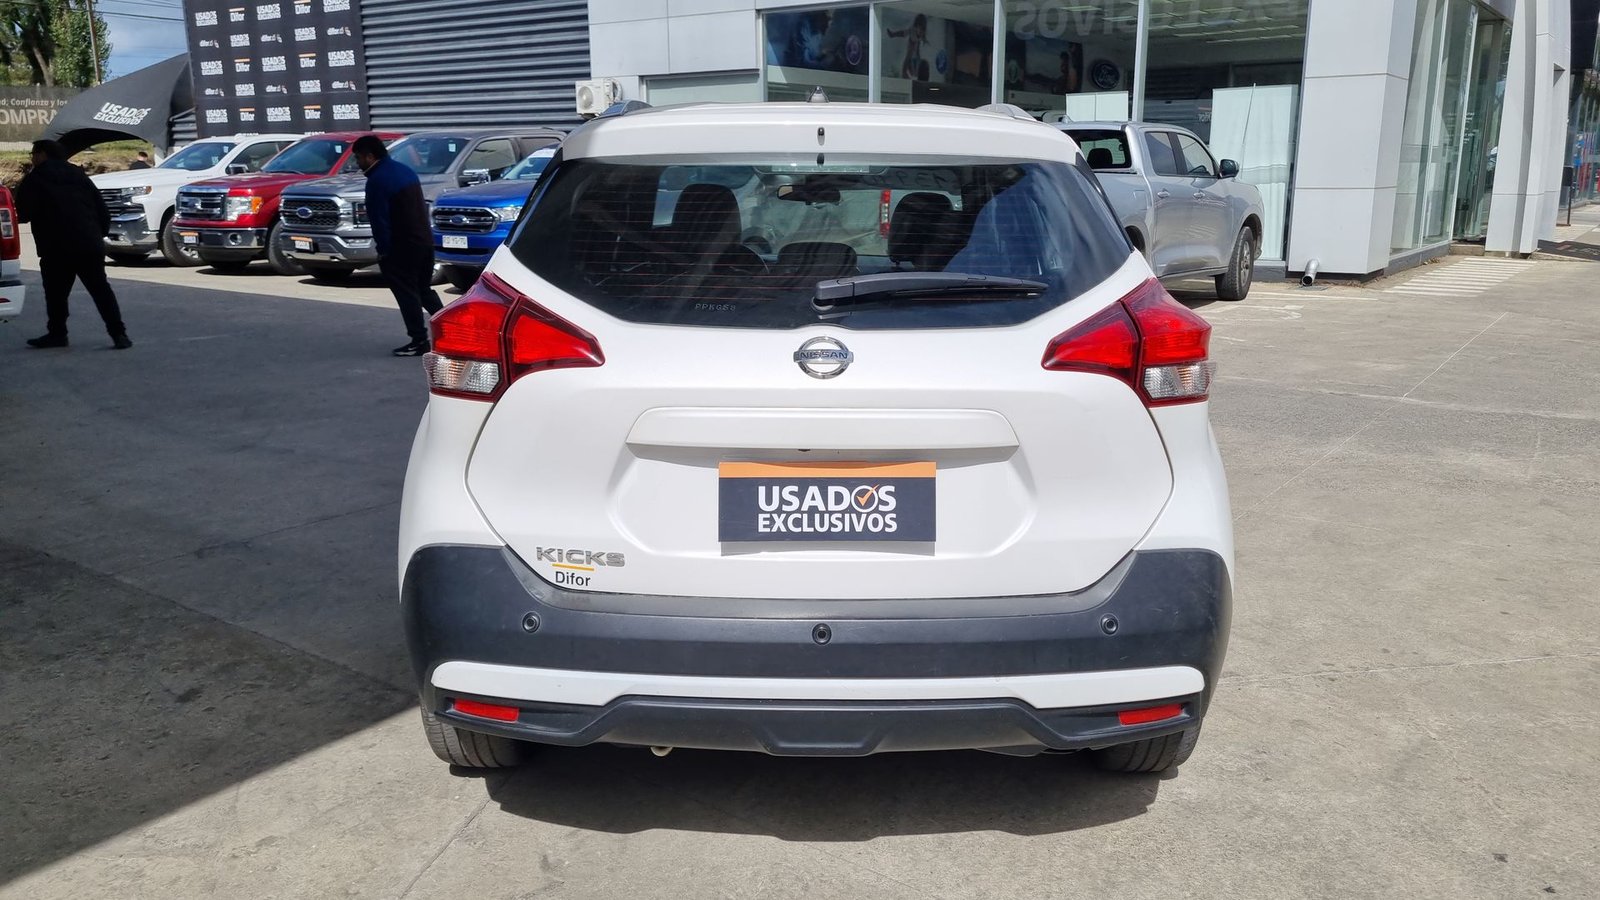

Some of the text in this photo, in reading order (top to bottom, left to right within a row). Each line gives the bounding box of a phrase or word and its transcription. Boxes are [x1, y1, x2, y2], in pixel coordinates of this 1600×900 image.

[101, 102, 151, 118] USADOS
[93, 112, 143, 125] EXCLUSIVOS
[800, 351, 848, 359] NISSAN
[758, 485, 896, 513] USADOS
[758, 513, 898, 533] EXCLUSIVOS
[536, 546, 625, 567] KICKS
[555, 571, 591, 586] Difor
